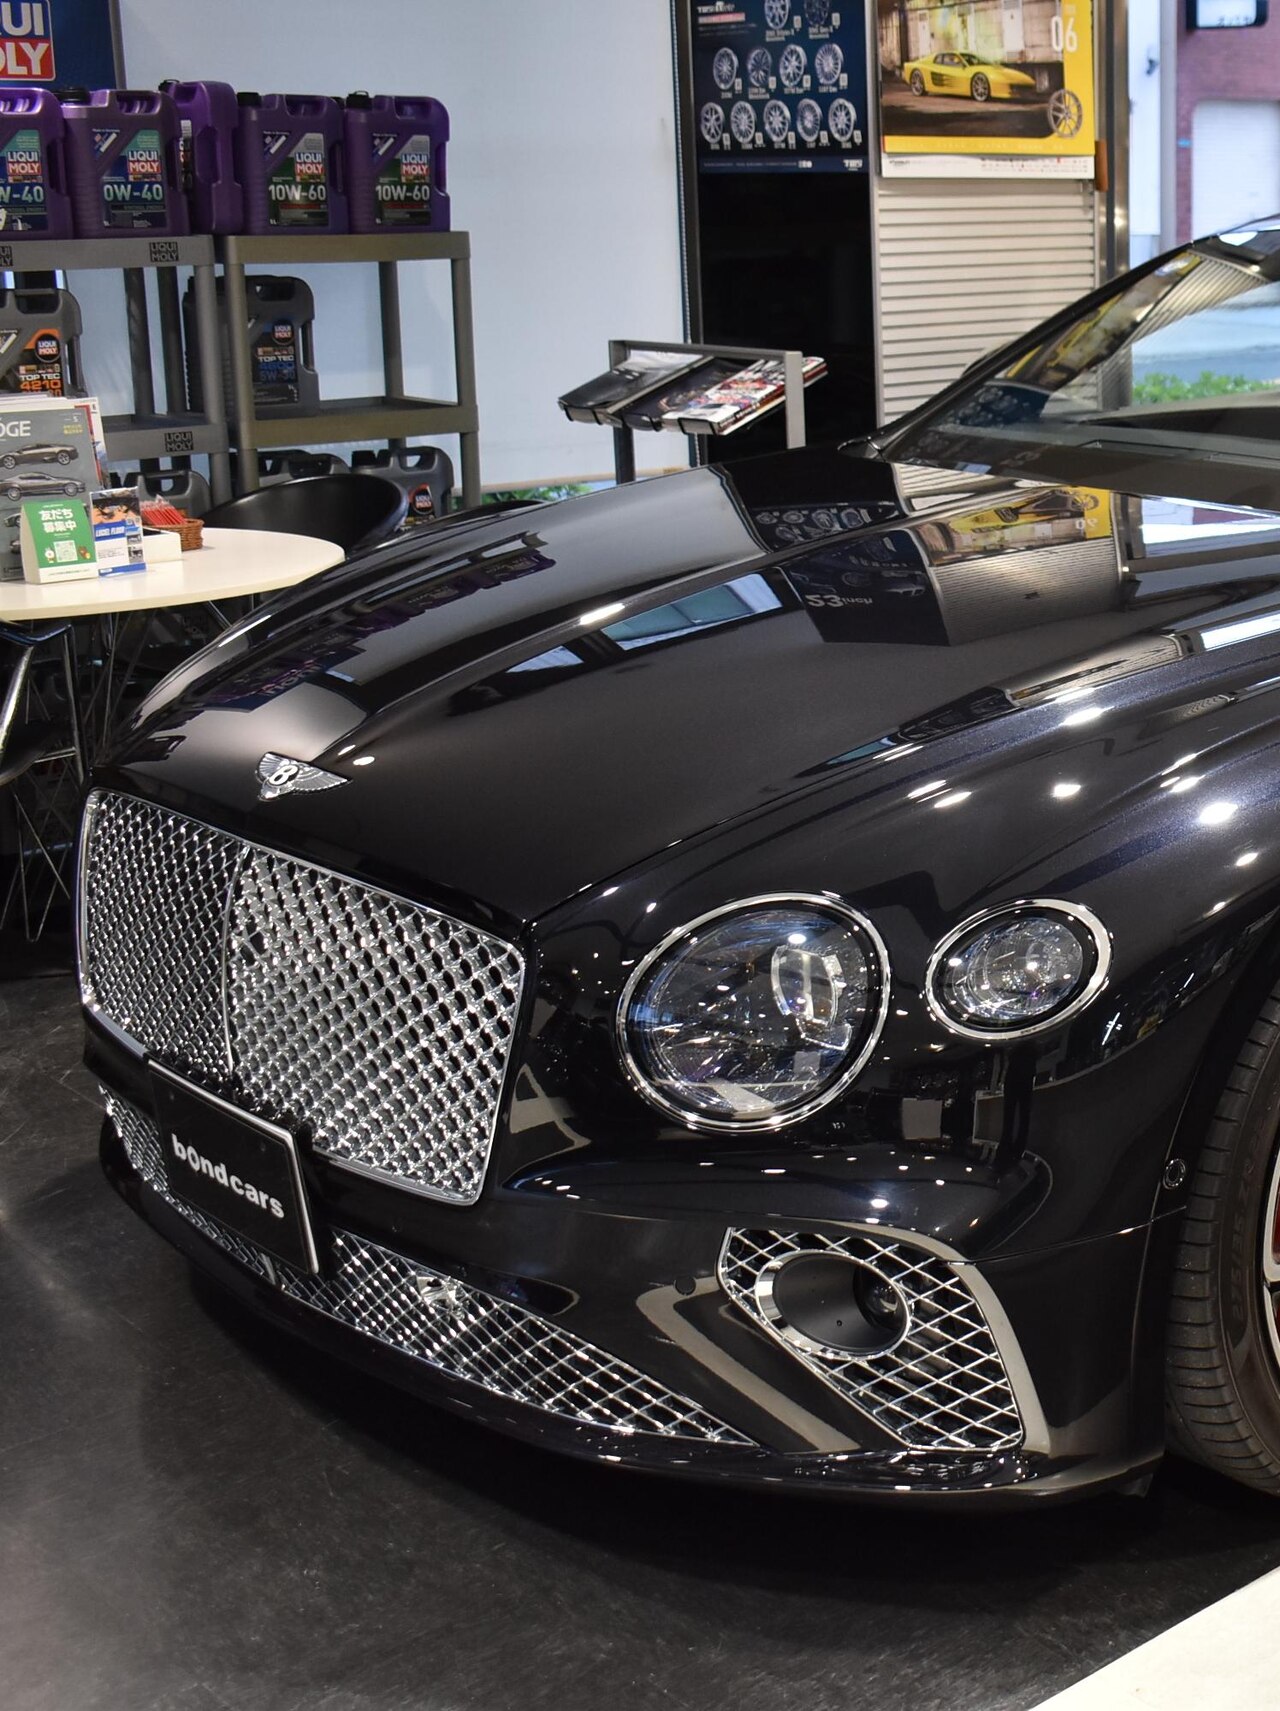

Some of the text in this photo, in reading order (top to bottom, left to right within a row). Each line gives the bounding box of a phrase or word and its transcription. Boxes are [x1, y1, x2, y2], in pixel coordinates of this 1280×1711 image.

[0, 2, 44, 36] UI
[1051, 16, 1077, 52] 06
[7, 151, 38, 162] LIQUI
[128, 151, 158, 161] LIQUI
[296, 153, 322, 163] LIQUI
[402, 154, 428, 164] LIQUI
[8, 163, 39, 174] MOLY
[129, 162, 160, 173] MOLY
[296, 164, 323, 174] MOLY
[402, 164, 429, 174] MOLY
[103, 184, 163, 201] 0W-40
[269, 184, 326, 201] 10W-60
[375, 185, 430, 201] 10W-60
[20, 380, 61, 390] 4210
[39, 508, 73, 521] 友だち
